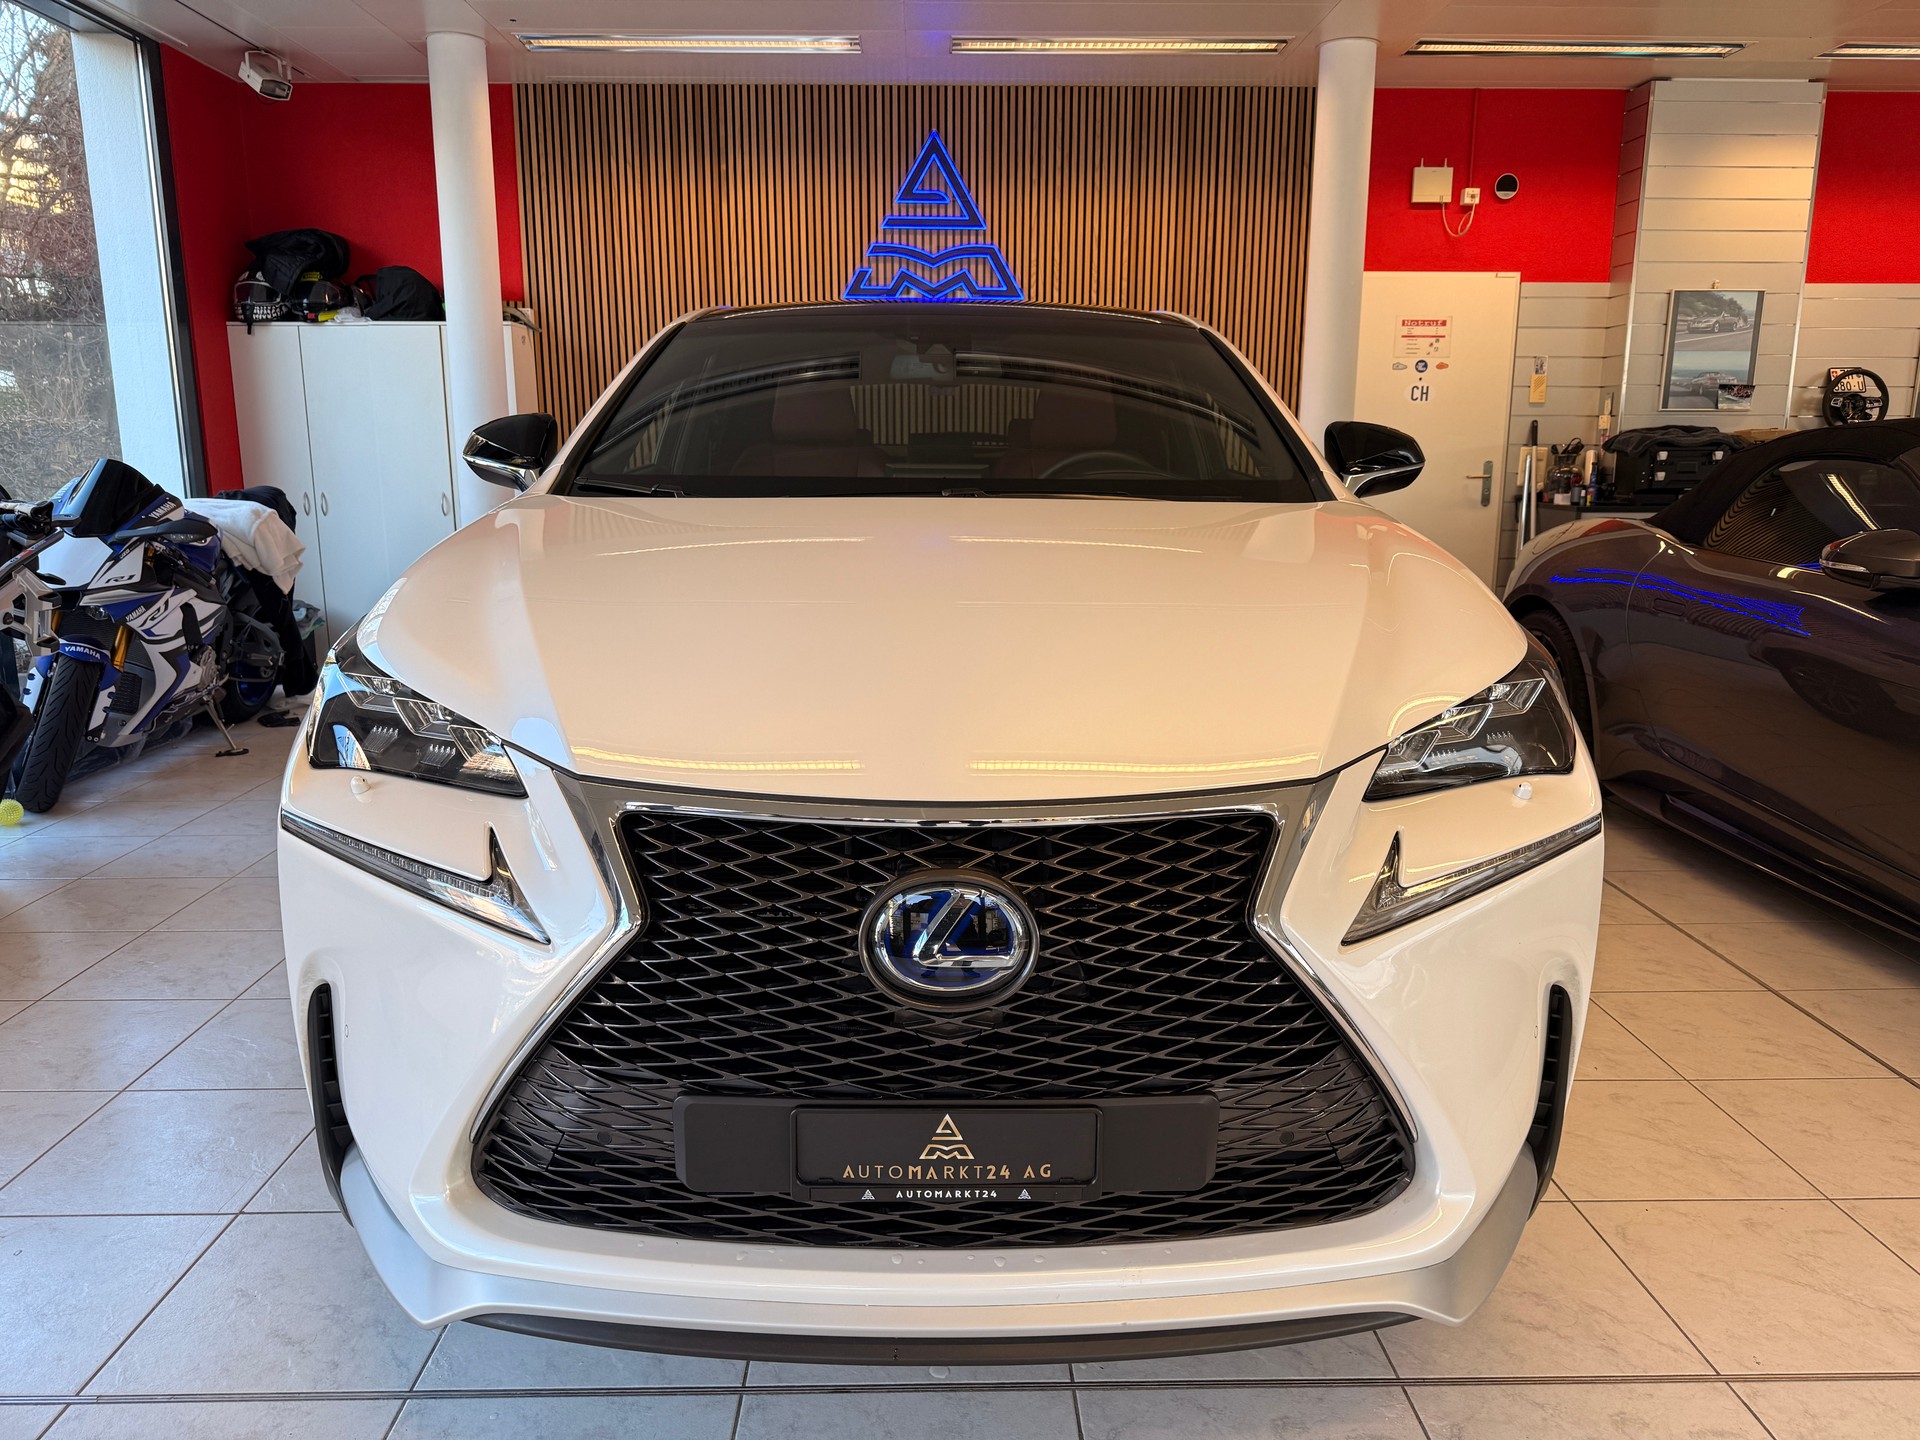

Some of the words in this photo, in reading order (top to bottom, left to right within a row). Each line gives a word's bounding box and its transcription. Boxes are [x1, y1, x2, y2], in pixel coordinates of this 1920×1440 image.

[1410, 385, 1429, 402] CH
[148, 501, 177, 519] YAMAHA
[105, 574, 136, 584] R1
[125, 605, 147, 622] YAMAHA
[64, 645, 101, 660] YAMAHA
[843, 1164, 1011, 1180] AUTOMARKT24
[1023, 1164, 1052, 1179] AG
[896, 1190, 998, 1199] AUTOMARKT24
